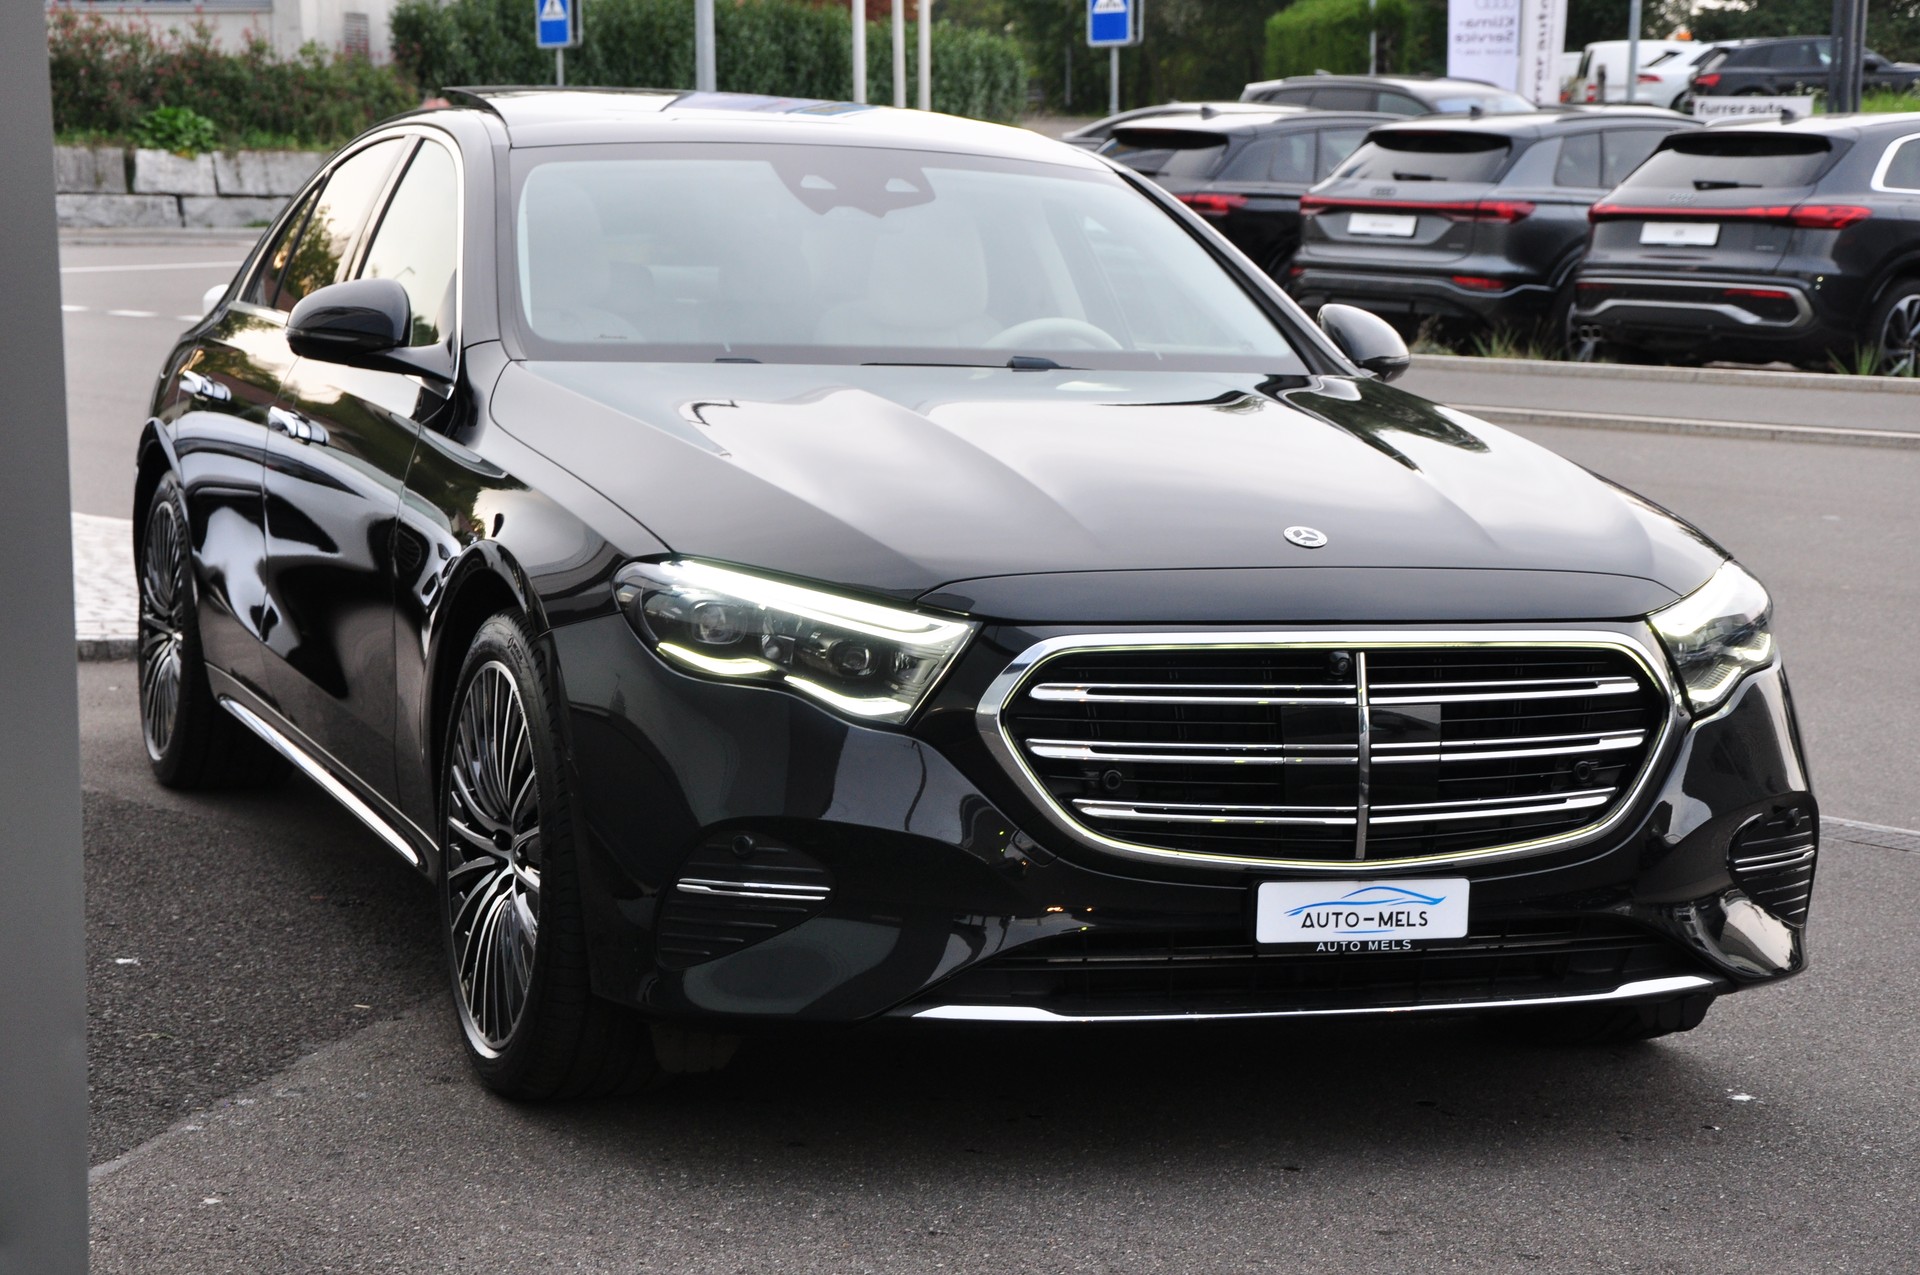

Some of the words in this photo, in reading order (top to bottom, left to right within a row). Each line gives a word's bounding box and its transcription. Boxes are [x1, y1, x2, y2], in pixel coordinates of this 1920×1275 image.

[1699, 102, 1744, 114] furrer
[1301, 911, 1428, 929] AUTO-MELS
[1316, 942, 1361, 952] AUTO
[1368, 939, 1412, 951] MELS
